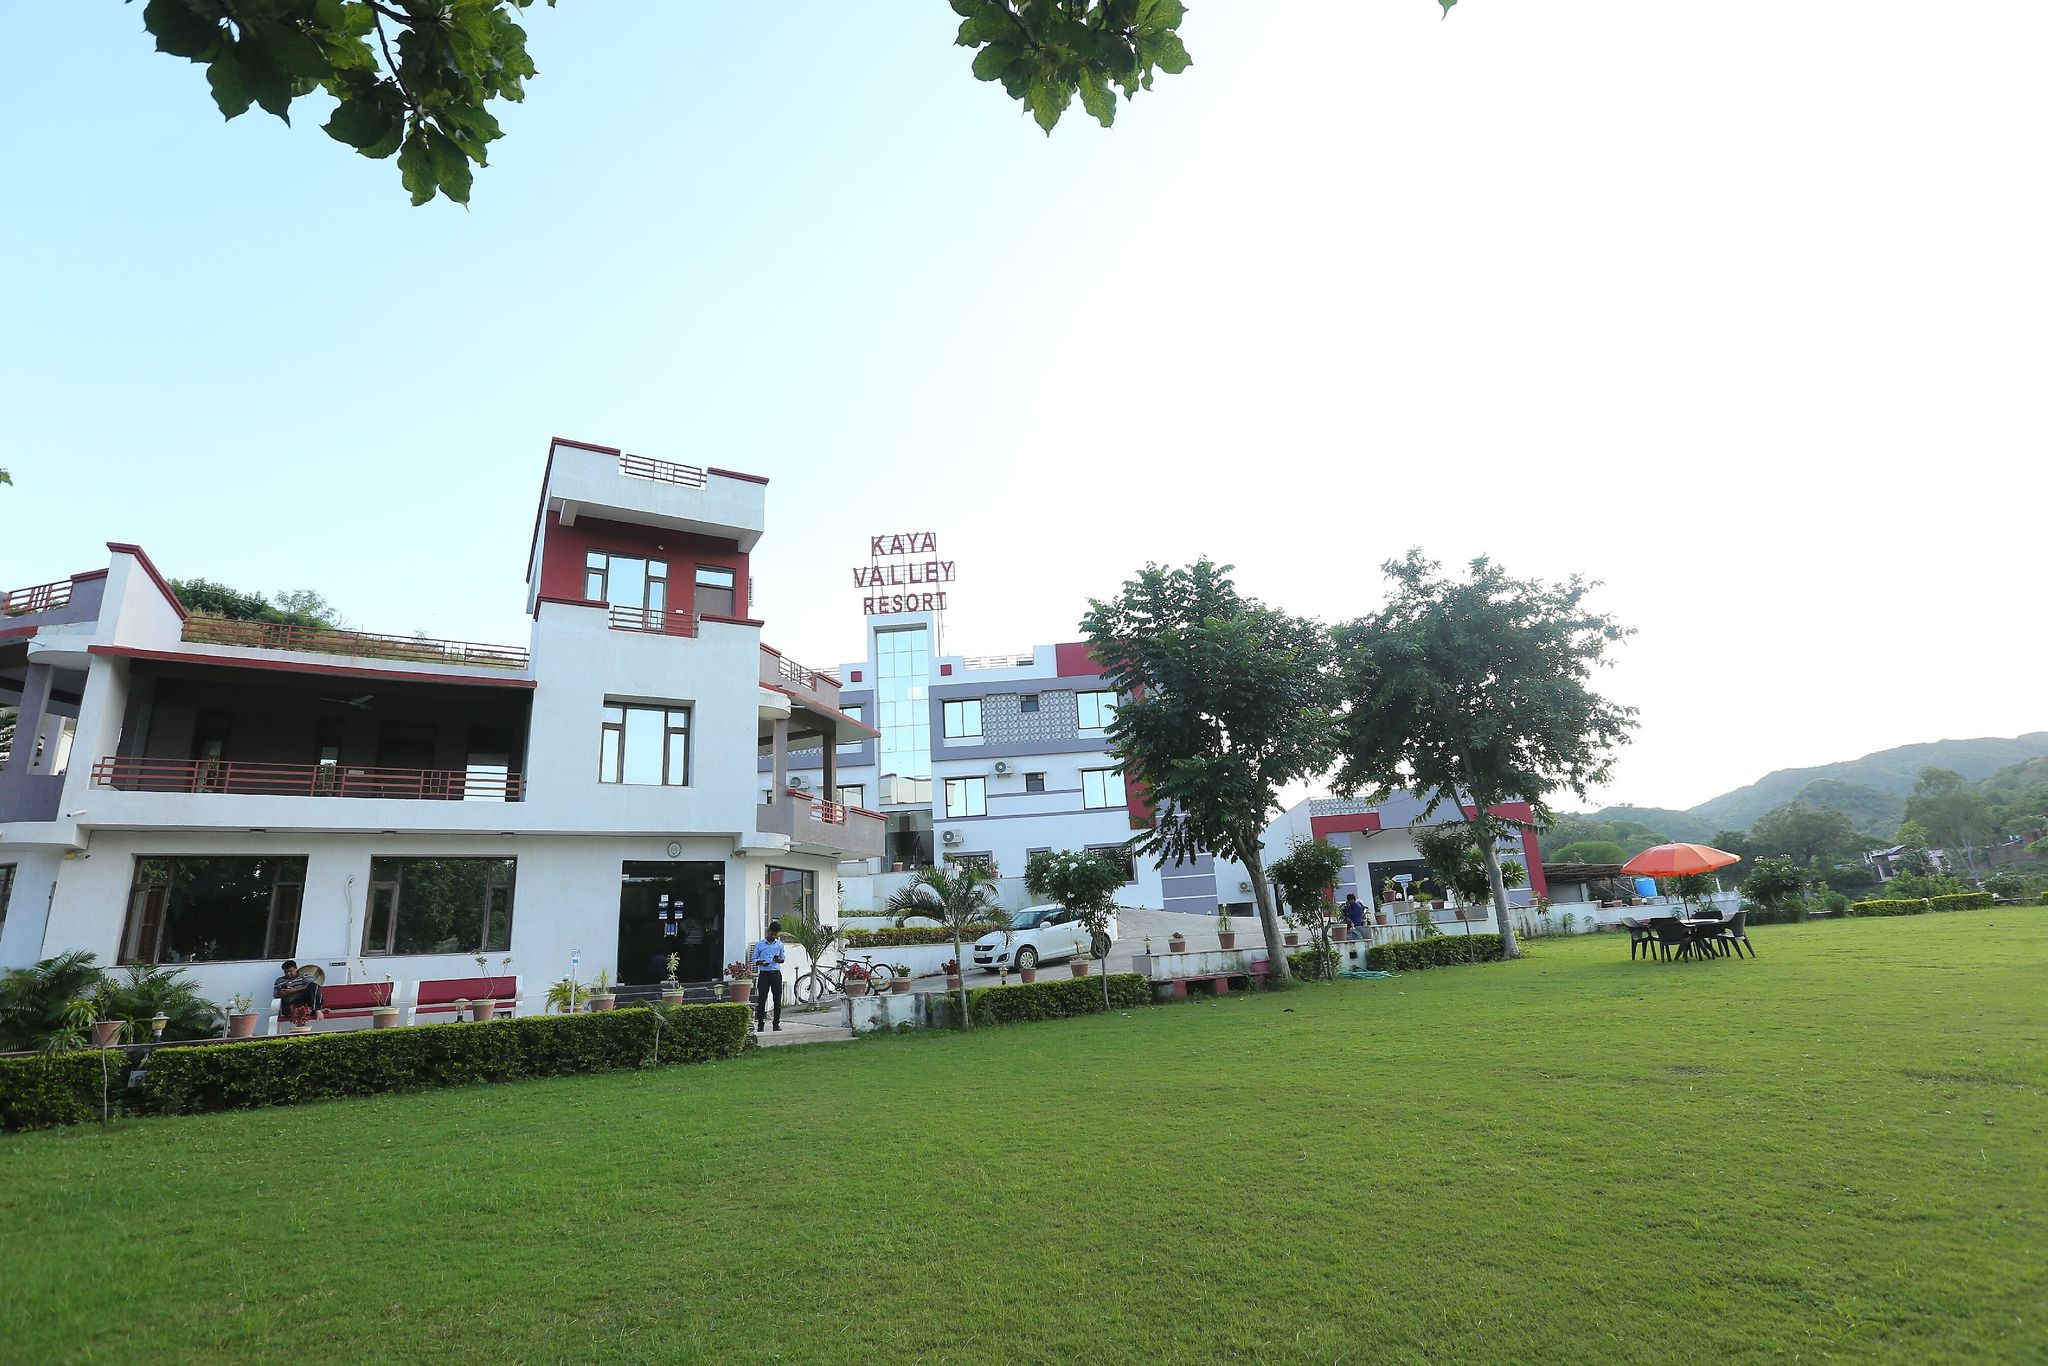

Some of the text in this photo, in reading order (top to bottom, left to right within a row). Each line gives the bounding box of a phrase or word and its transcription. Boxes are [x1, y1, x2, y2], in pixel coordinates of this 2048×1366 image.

[872, 532, 936, 556] KAYA
[853, 561, 954, 587] VALLEY
[864, 592, 946, 615] RESORT
